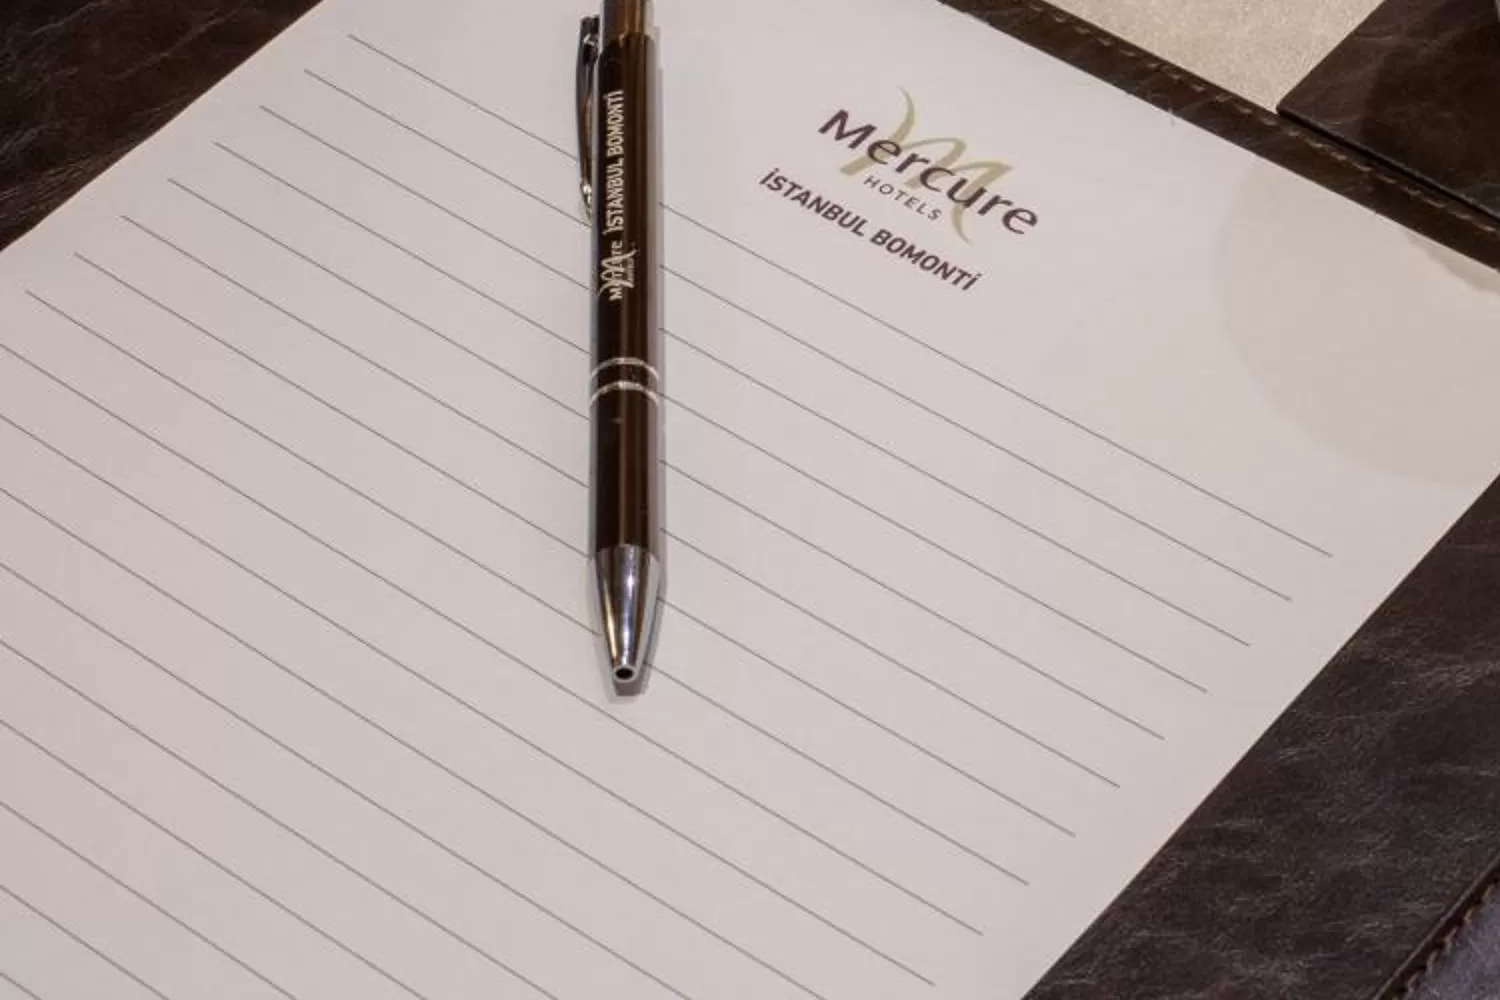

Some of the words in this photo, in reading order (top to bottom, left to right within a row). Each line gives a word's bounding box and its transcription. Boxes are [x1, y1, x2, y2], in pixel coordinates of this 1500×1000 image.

[602, 89, 625, 158] BOMONTİ
[602, 158, 625, 236] İSTANBUL
[817, 108, 1040, 236] Mercure
[863, 174, 944, 222] HOTELS
[758, 167, 866, 238] İSTANBUL
[869, 228, 983, 292] BOMONTİ
